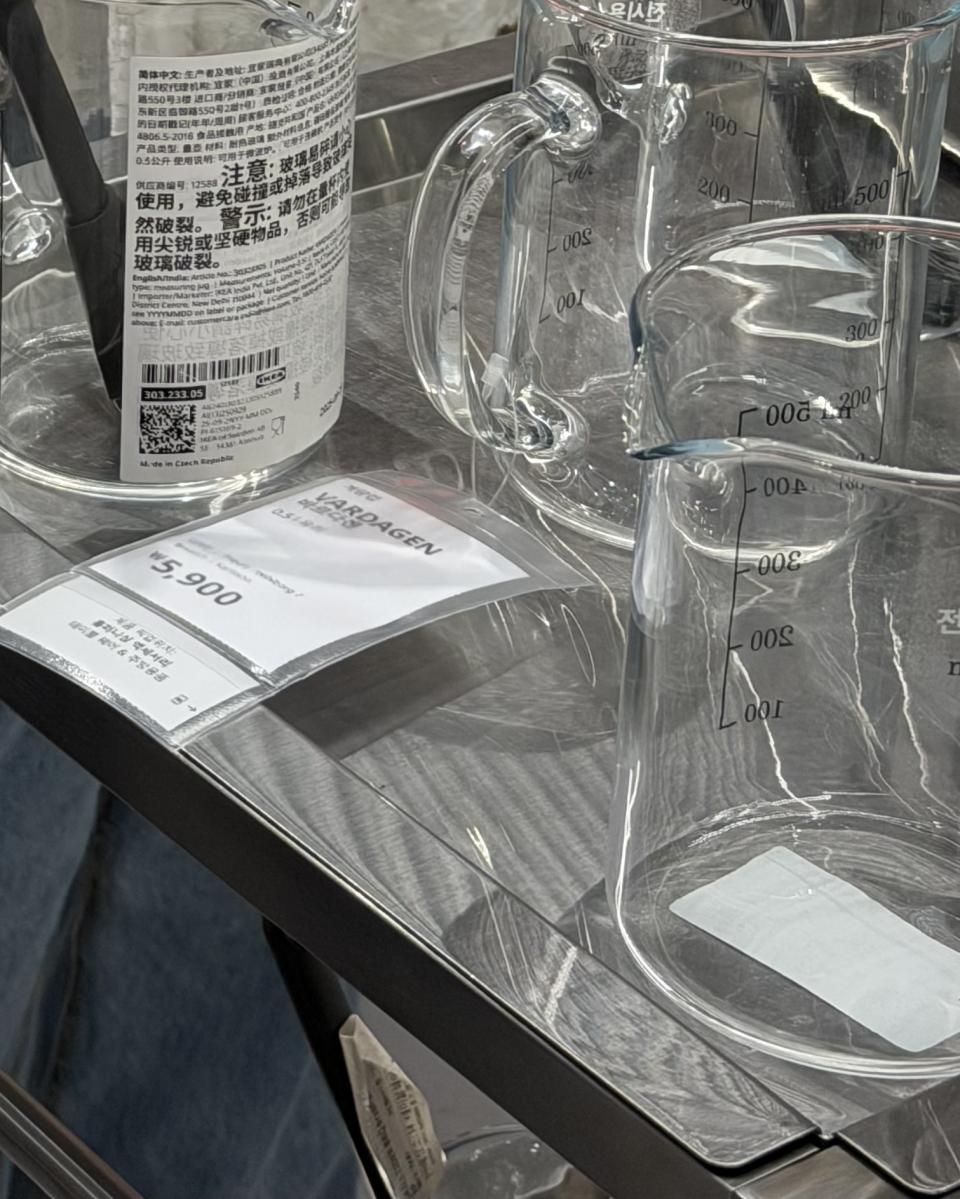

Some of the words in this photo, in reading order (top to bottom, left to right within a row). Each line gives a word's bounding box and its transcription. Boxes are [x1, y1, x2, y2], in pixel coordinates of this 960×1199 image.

[698, 177, 730, 204] 200
[854, 179, 890, 206] 500
[135, 216, 202, 234] 然破裂。
[134, 251, 219, 271] 玻璃破裂。
[846, 318, 878, 342] 300
[143, 388, 204, 400] 303.233.05
[258, 370, 284, 385] IKEA
[840, 386, 871, 409] 200
[315, 492, 443, 556] VARDAGEN
[133, 641, 174, 667] 액세서리
